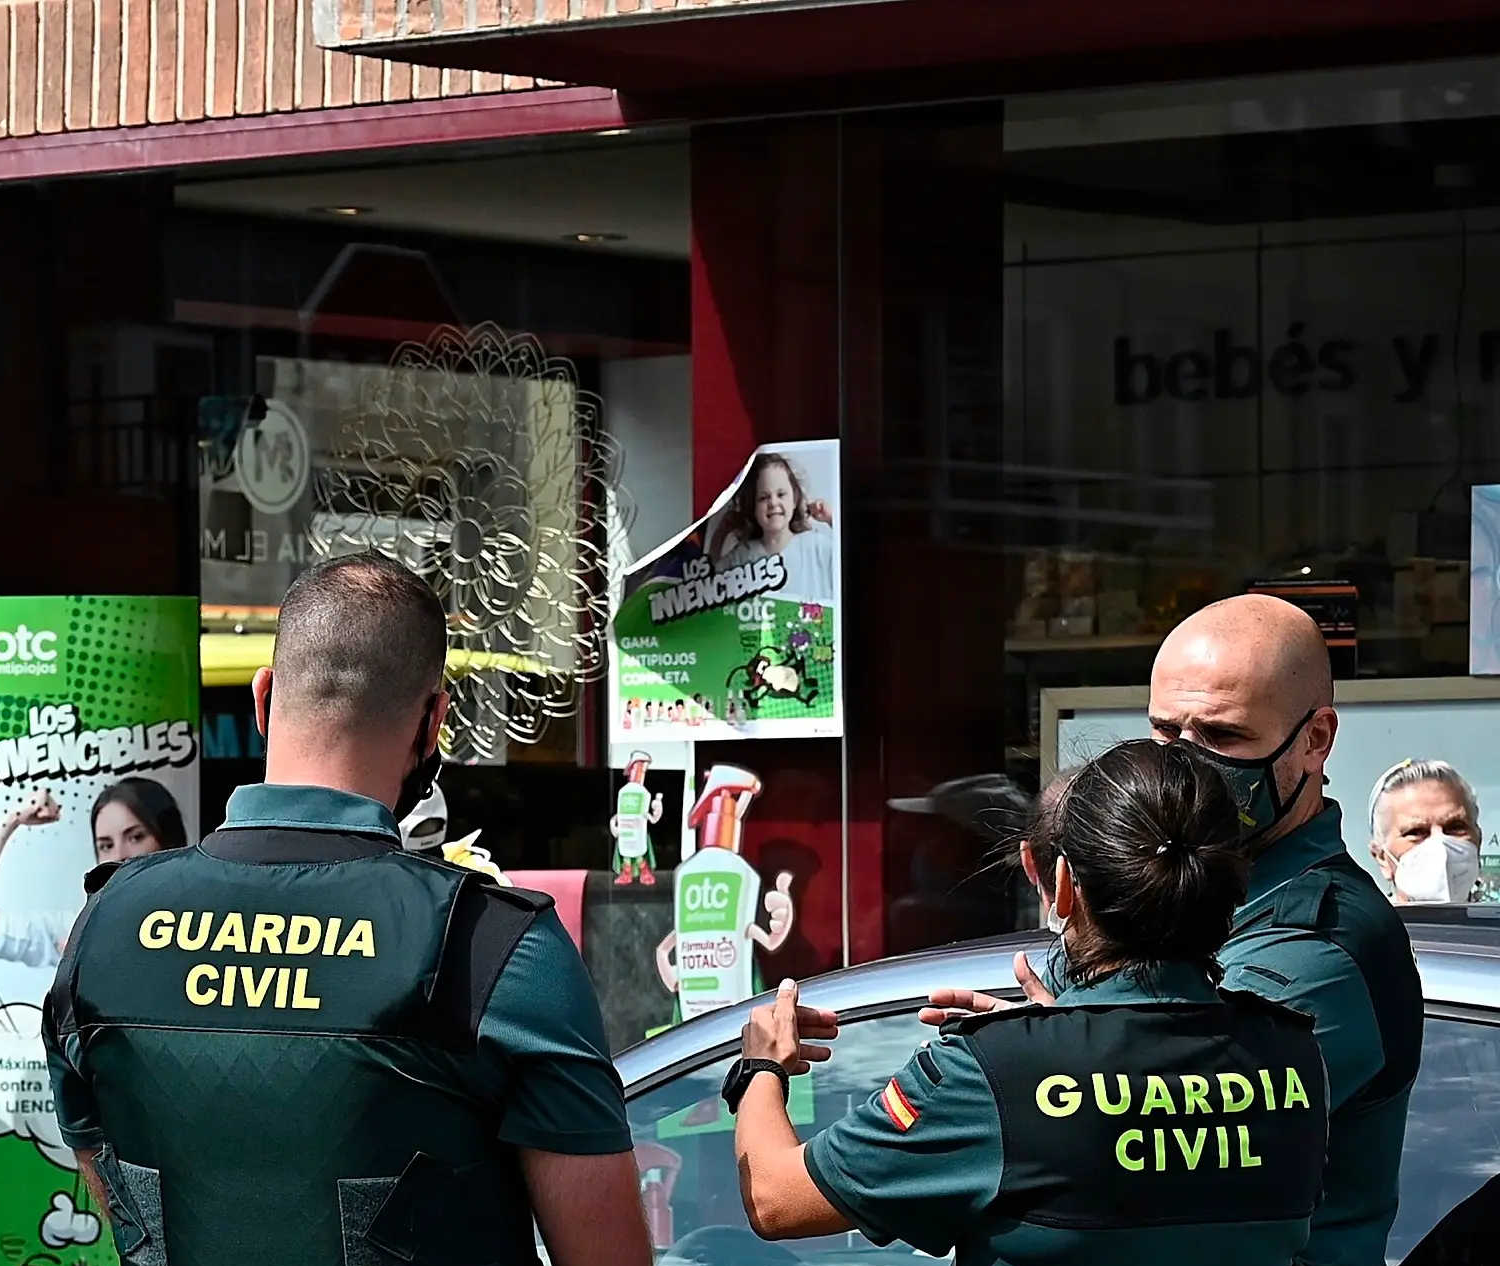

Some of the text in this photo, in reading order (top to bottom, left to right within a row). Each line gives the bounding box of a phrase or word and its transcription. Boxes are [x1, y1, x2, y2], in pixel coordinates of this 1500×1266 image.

[1113, 322, 1355, 406] bebés
[1392, 332, 1439, 401] y
[682, 555, 711, 581] LOS
[737, 594, 776, 621] otc
[620, 637, 659, 649] GAMA
[622, 653, 697, 666] ANTIPIOJOS
[622, 671, 691, 685] COMPLETA
[28, 703, 77, 736] LOS
[685, 877, 730, 911] otc
[138, 910, 376, 958] GUARDIA
[682, 954, 718, 969] TOTAL
[185, 963, 321, 1010] CIVIL
[1035, 1067, 1310, 1118] GUARDIA
[1115, 1125, 1262, 1171] CIVIL
